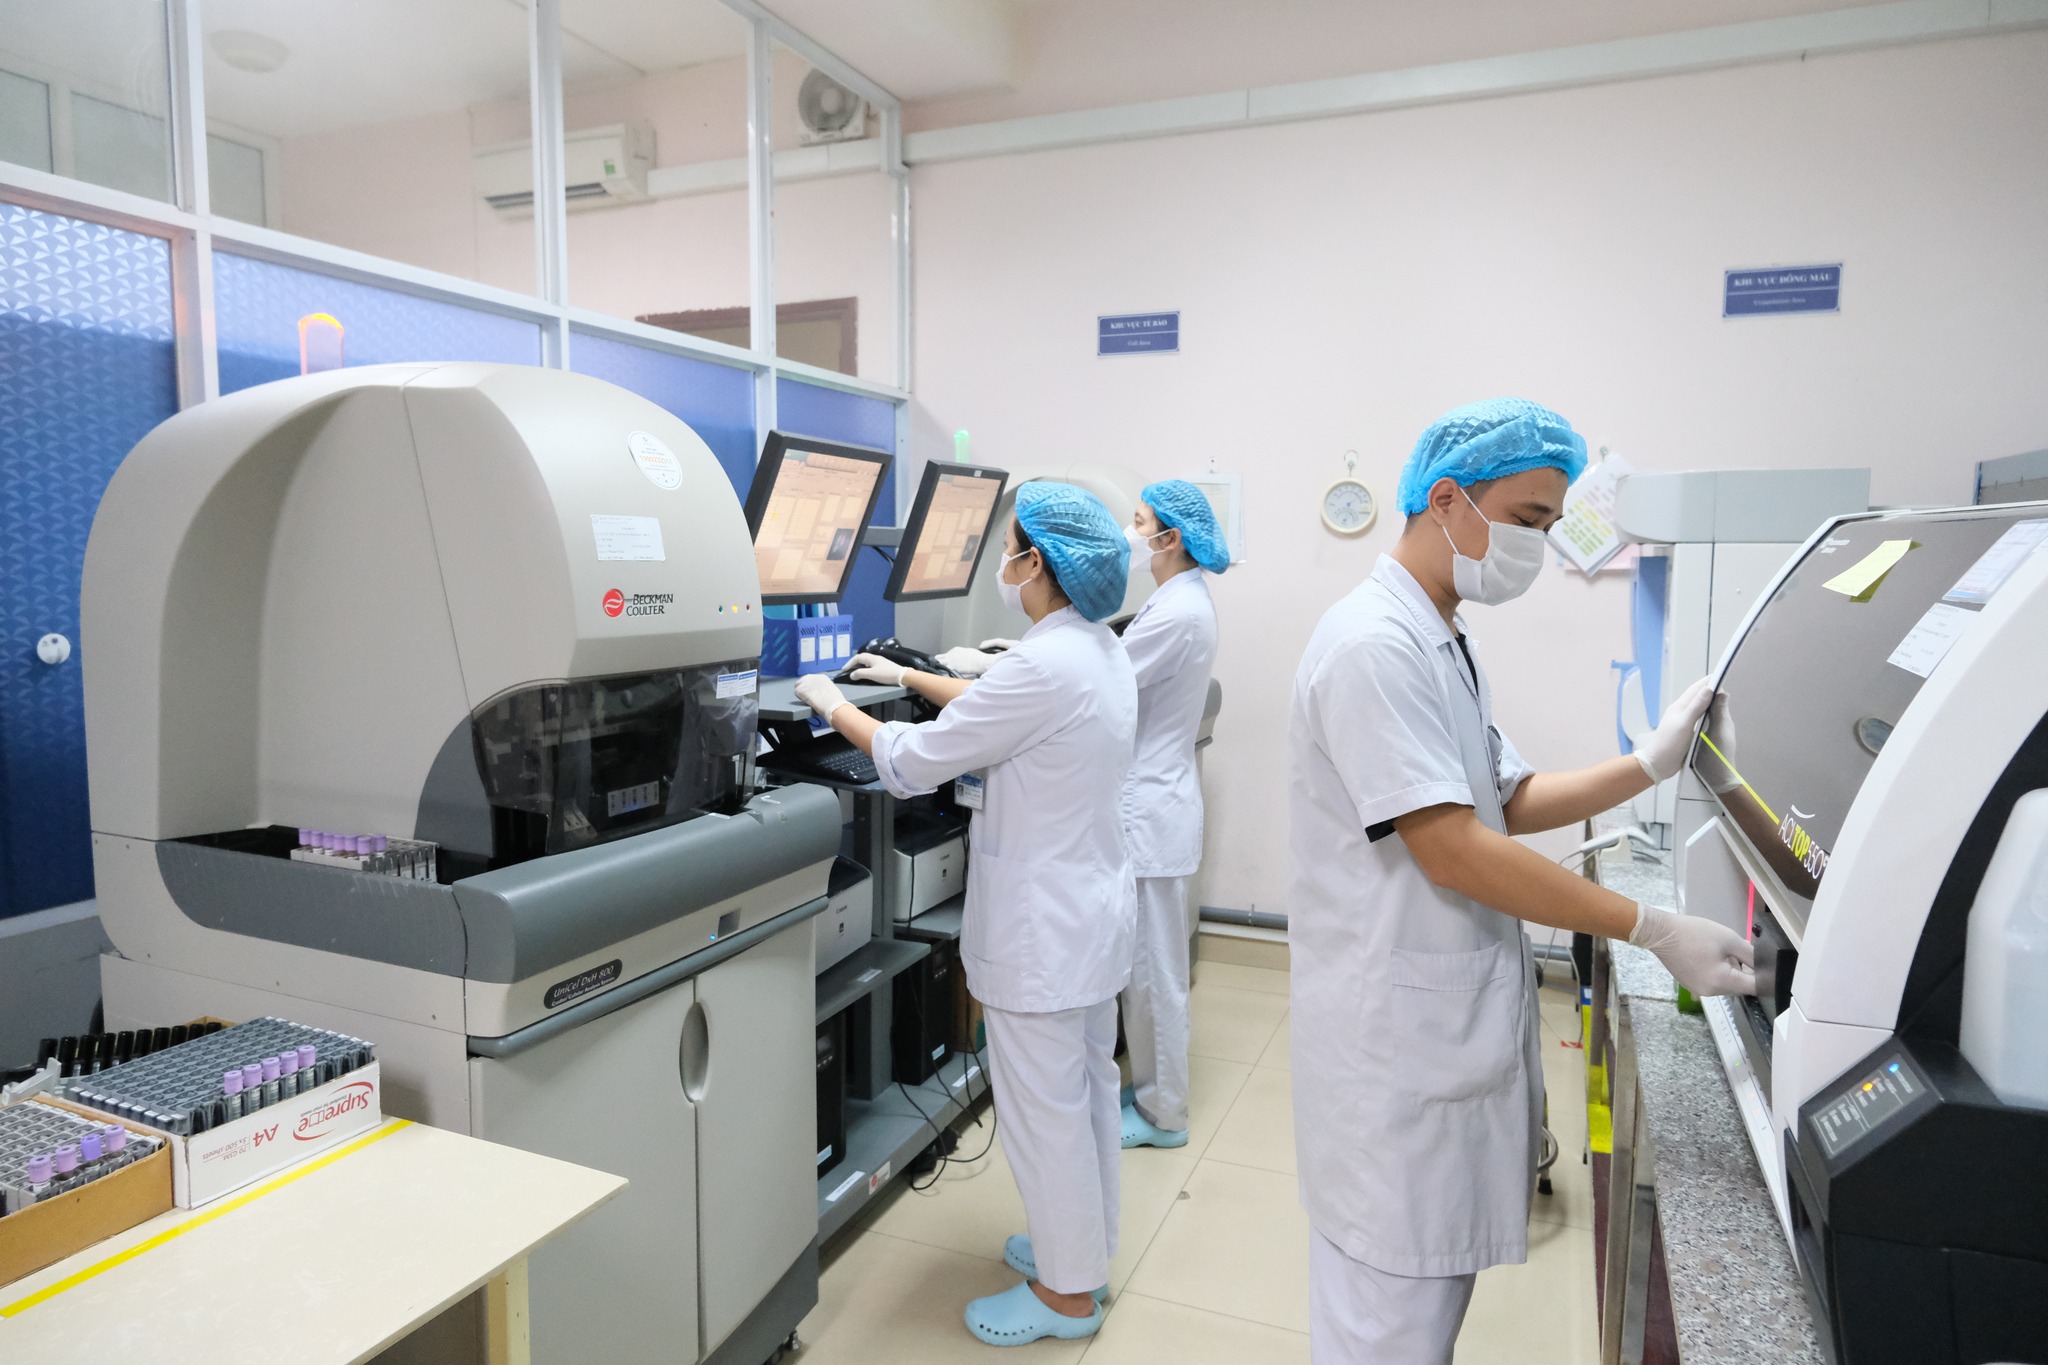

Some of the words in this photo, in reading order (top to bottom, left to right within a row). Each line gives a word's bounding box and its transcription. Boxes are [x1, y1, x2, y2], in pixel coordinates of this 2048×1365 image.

[1735, 278, 1753, 286] KHU
[632, 594, 674, 605] BECKMAN
[626, 605, 665, 616] COULTER
[554, 979, 580, 997] UniCel
[582, 973, 597, 986] DxH
[599, 966, 614, 979] 800
[252, 1123, 279, 1147] A4
[202, 1146, 224, 1160] sheets
